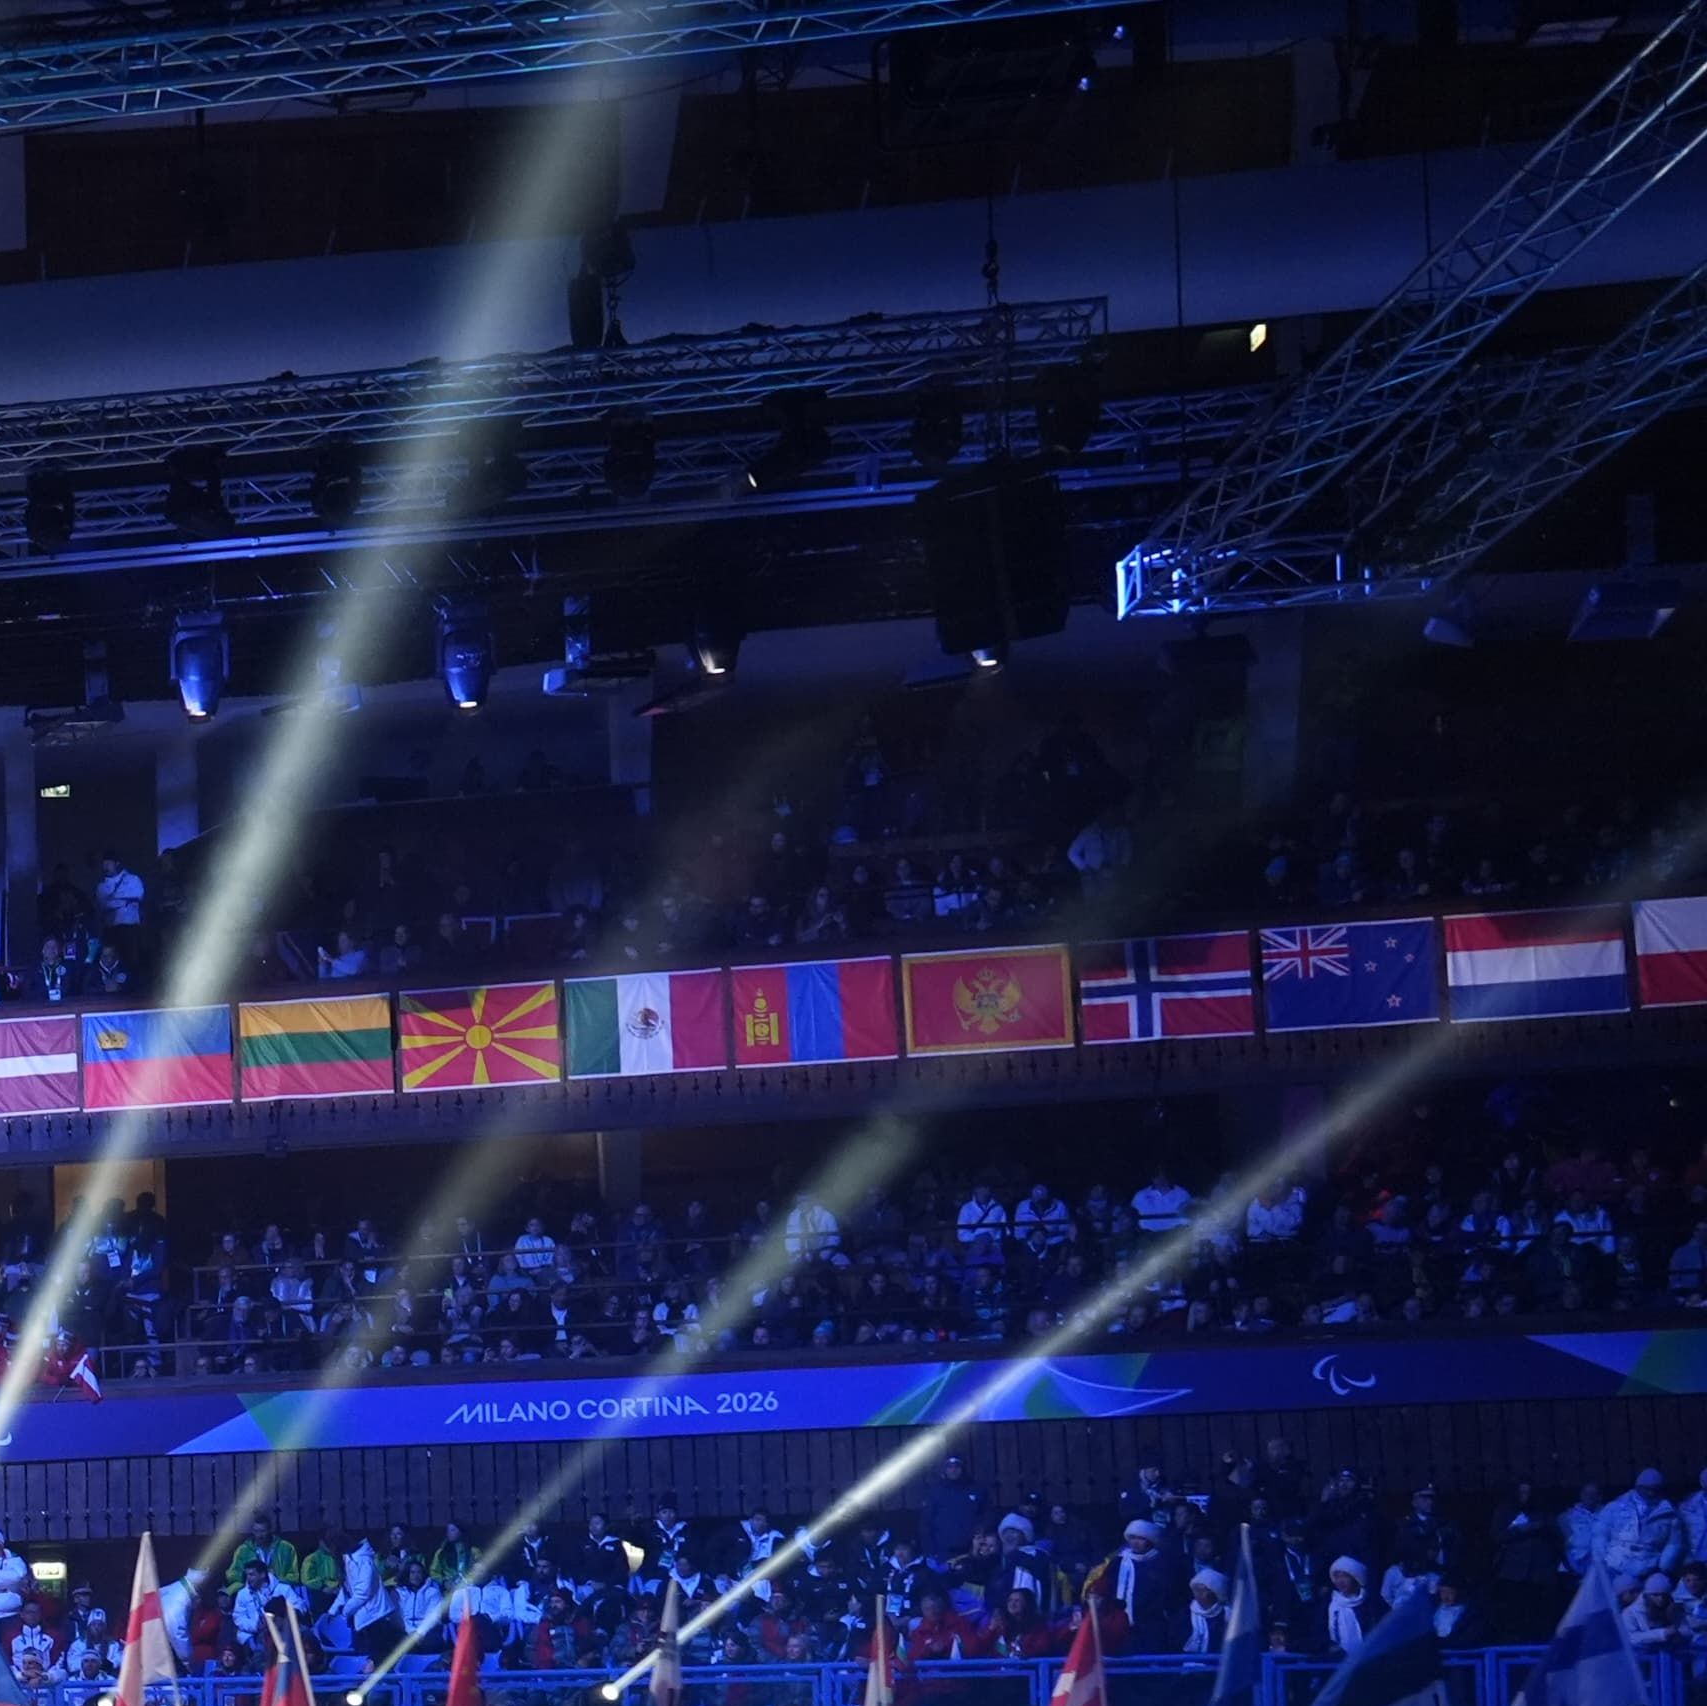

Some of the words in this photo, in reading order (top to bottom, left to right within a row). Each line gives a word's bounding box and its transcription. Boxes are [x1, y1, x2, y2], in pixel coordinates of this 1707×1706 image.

[444, 1399, 571, 1425] MILANO
[576, 1395, 711, 1419] CORTINA
[716, 1391, 779, 1413] 2026
